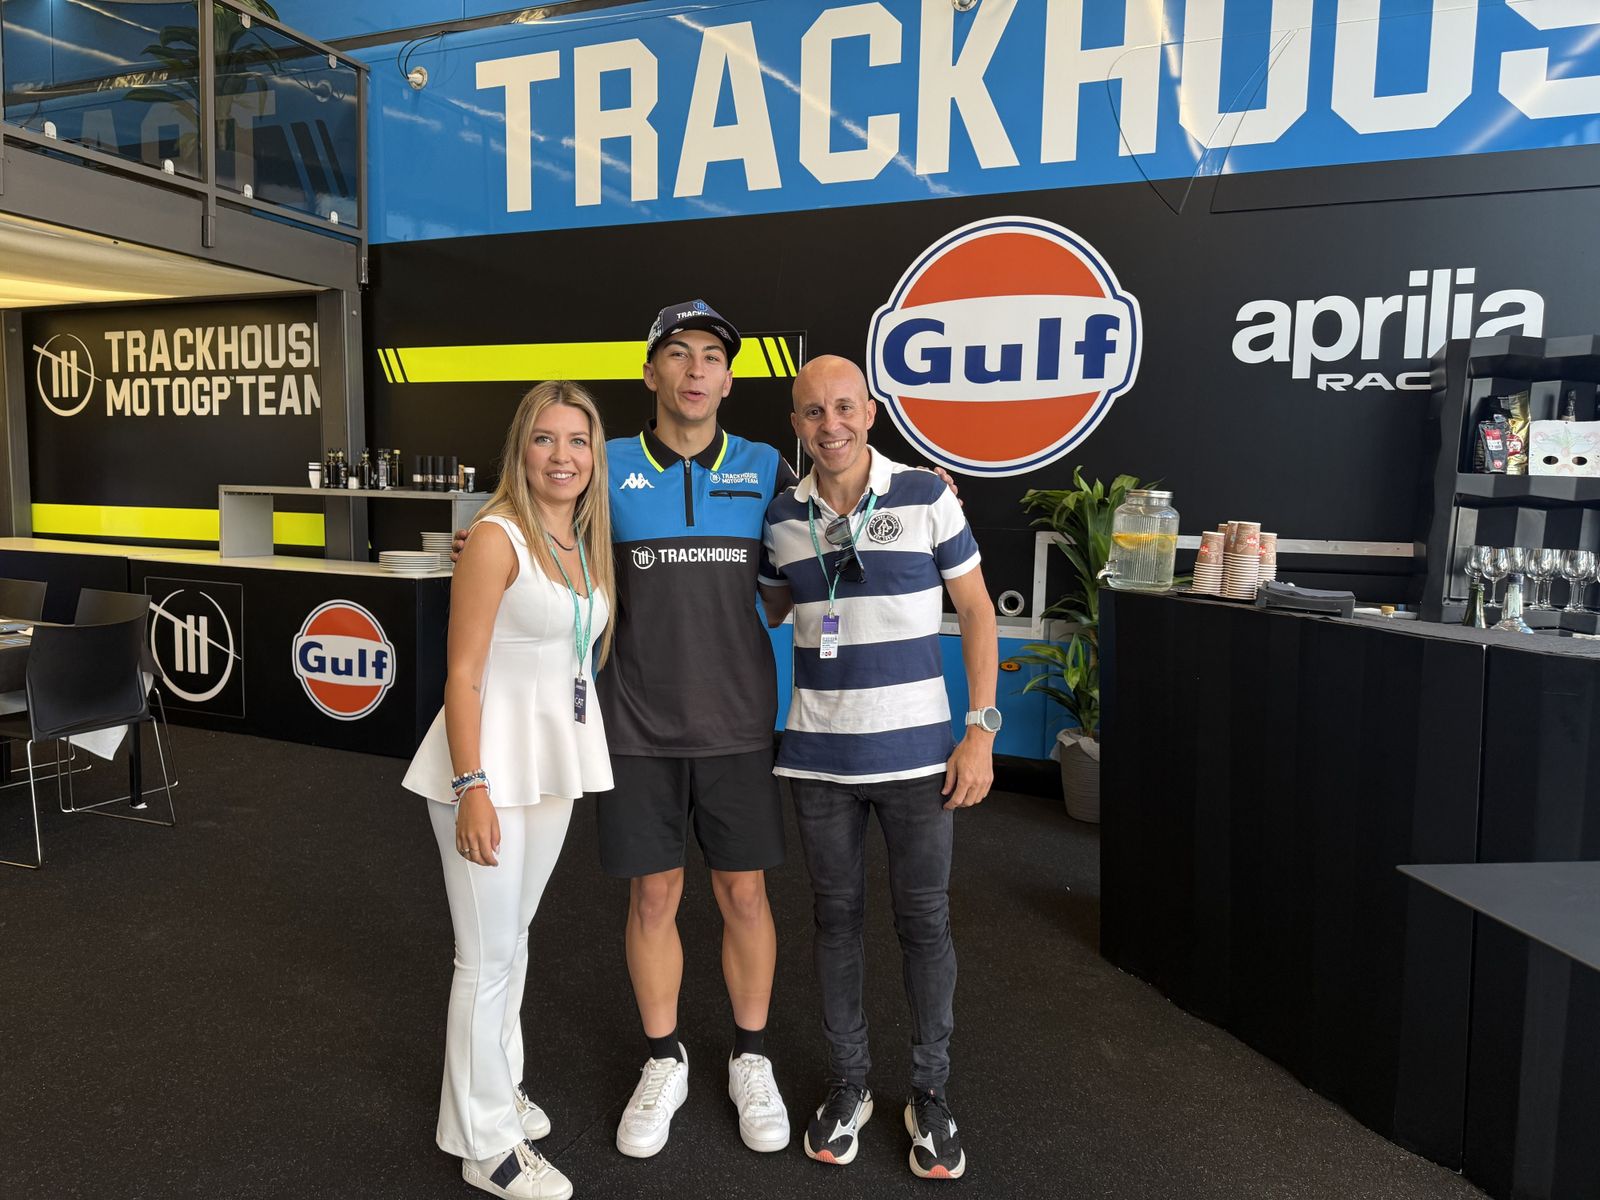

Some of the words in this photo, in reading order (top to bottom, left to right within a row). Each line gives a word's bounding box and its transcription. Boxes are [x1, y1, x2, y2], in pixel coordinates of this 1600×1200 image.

[882, 313, 1121, 386] Gulf
[1231, 267, 1545, 379] aprilia
[658, 548, 748, 563] TRACKHOUSE
[298, 641, 389, 680] Gulf
